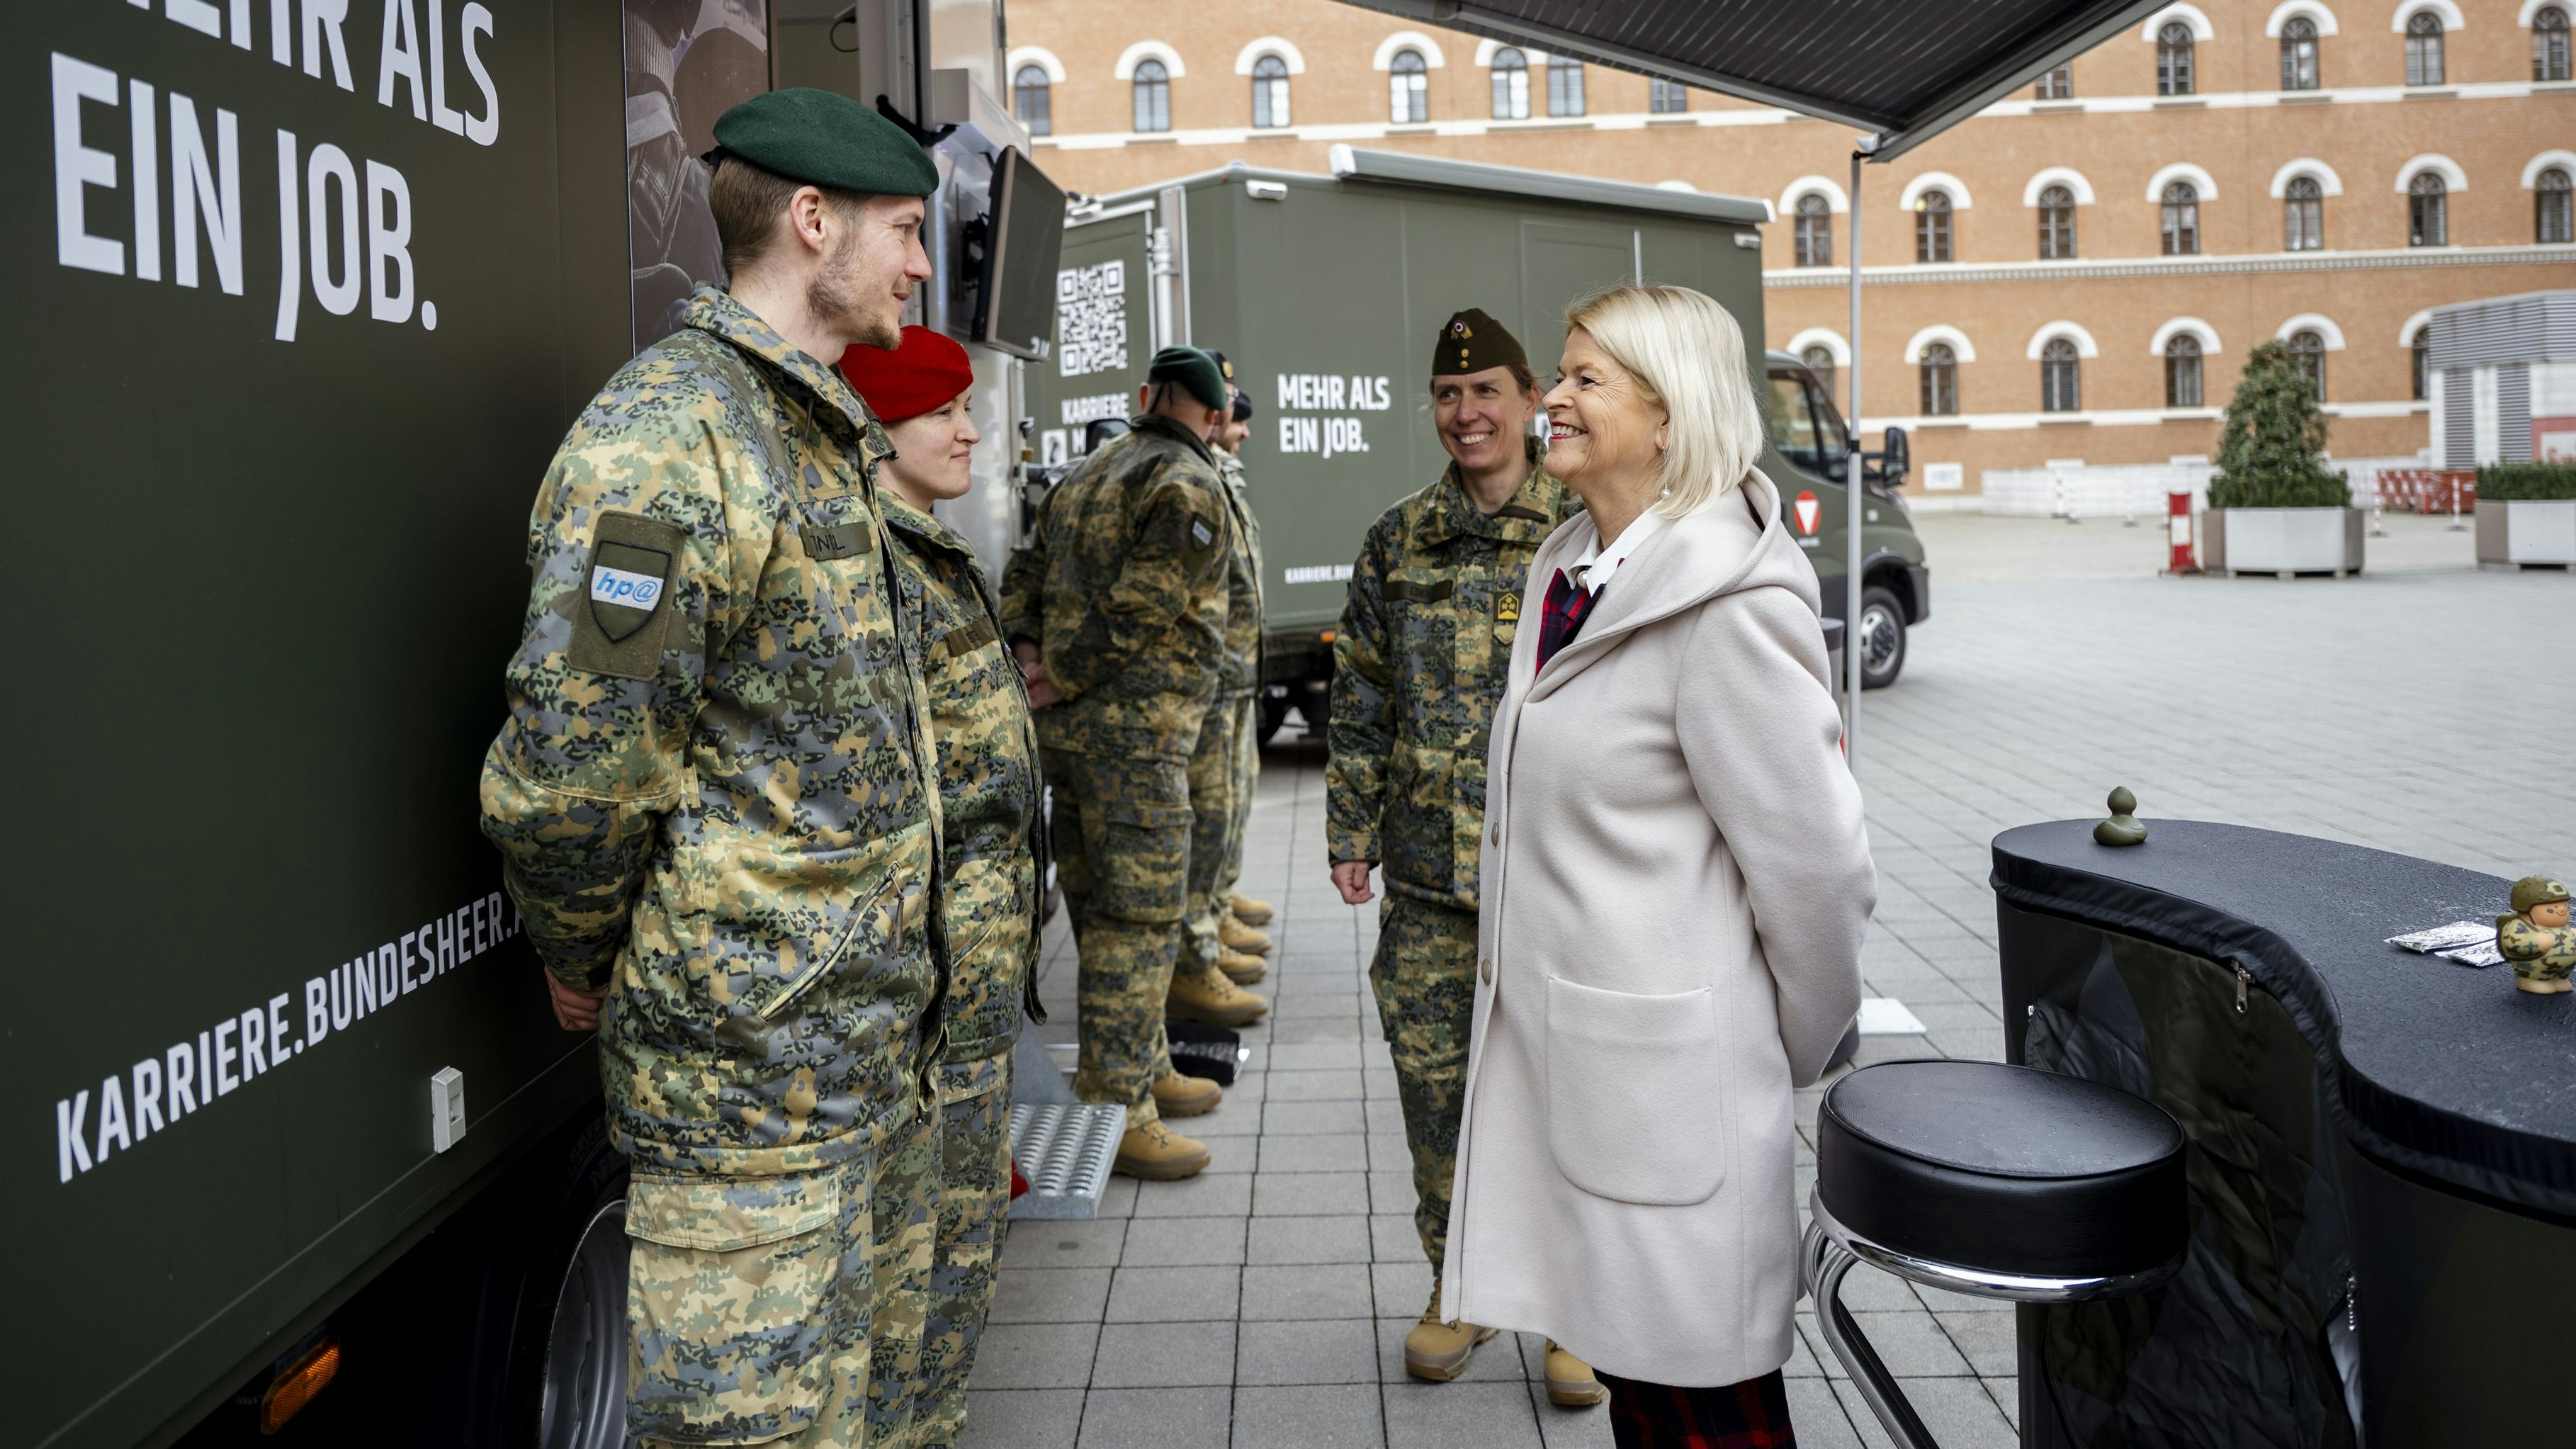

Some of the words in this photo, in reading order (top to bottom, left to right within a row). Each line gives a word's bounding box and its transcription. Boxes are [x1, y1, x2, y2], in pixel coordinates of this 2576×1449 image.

[378, 0, 499, 147] ALS
[52, 51, 244, 296] EIN
[275, 128, 438, 343] JOB.
[1061, 393, 1131, 425] KARRIERE
[1277, 373, 1346, 410] MEHR
[1349, 375, 1391, 411] ALS
[1279, 417, 1319, 453] EIN
[1322, 417, 1370, 459] JOB.
[596, 572, 658, 602] hp@
